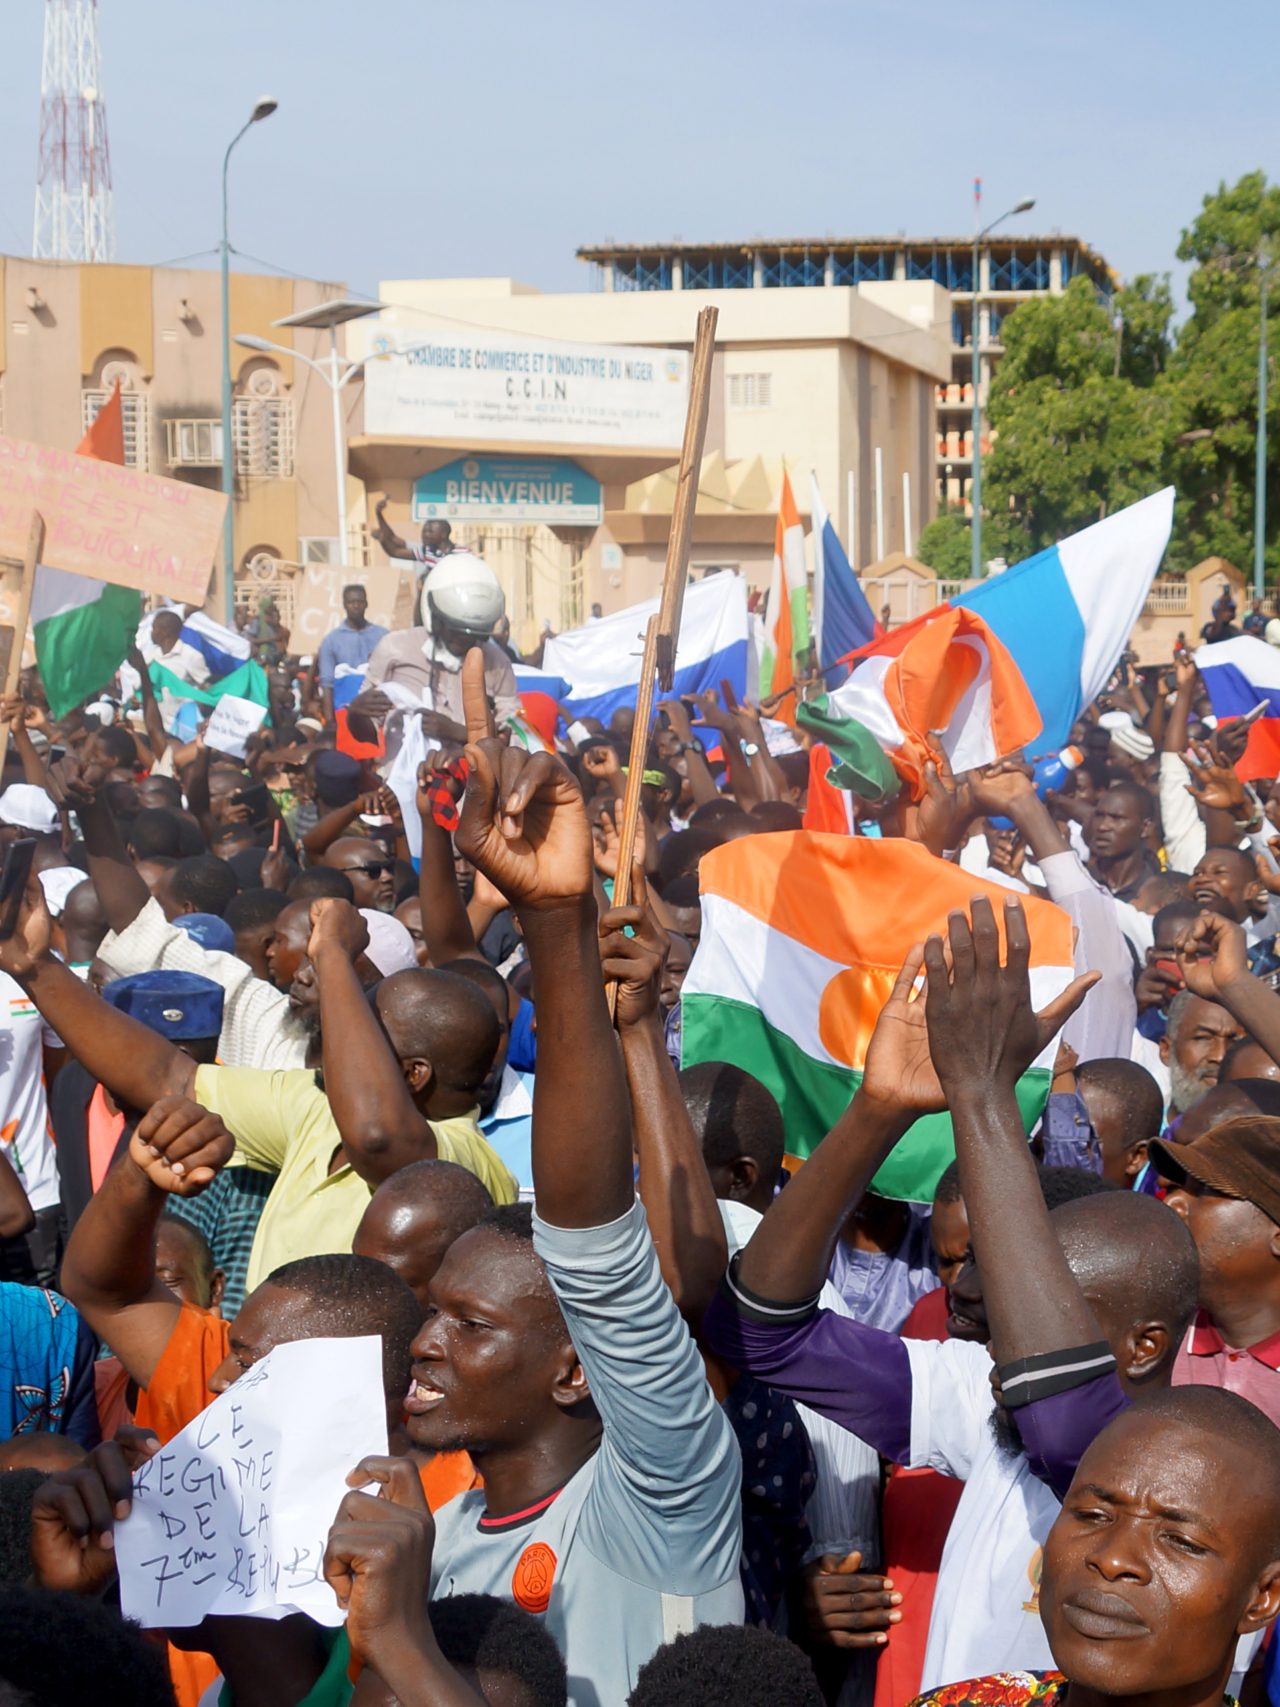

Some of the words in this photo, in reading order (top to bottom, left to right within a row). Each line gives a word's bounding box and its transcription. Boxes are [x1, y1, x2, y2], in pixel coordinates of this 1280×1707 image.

[406, 346, 455, 368] CHAMBRE
[460, 349, 472, 369] DE
[475, 350, 530, 372] COMMERCE
[533, 352, 544, 373] ET
[610, 358, 621, 379] DU
[624, 360, 654, 382] NIGER
[87, 491, 153, 528] EST
[446, 480, 574, 504] BIENVENUE
[132, 1450, 273, 1501] REGIME
[159, 1501, 216, 1541] DE
[239, 1495, 269, 1538] LA
